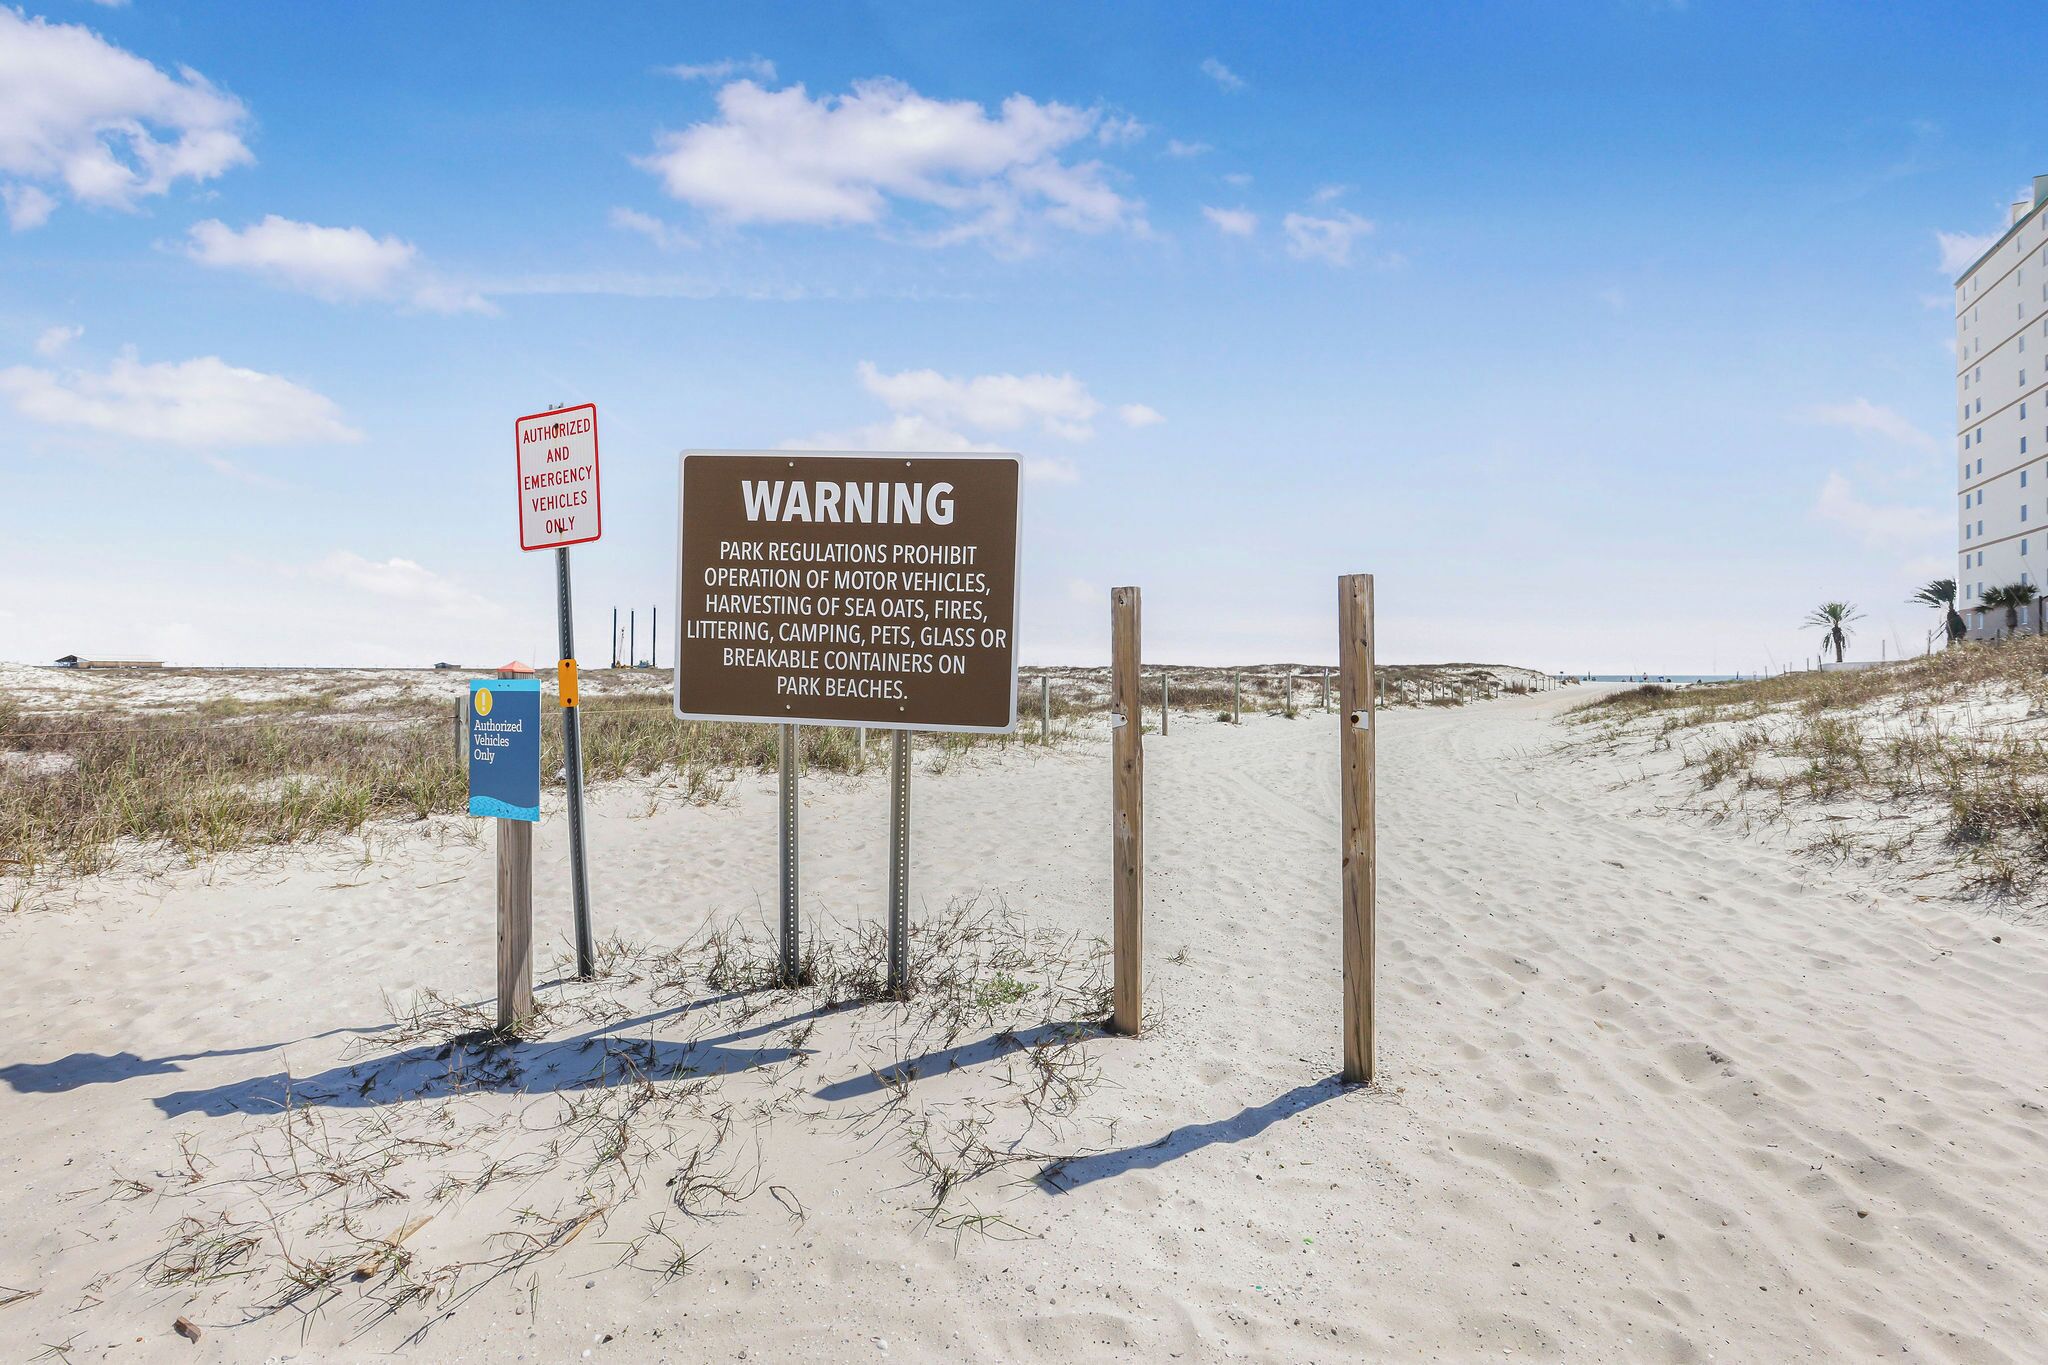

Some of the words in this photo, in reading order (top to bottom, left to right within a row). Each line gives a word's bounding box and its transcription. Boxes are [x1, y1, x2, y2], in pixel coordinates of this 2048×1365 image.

[523, 418, 591, 444] AUTHORIZED
[547, 446, 570, 464] AND
[524, 465, 593, 491] EMERGENCY
[532, 490, 588, 512] VEHICLES
[742, 480, 954, 525] WARNING
[545, 516, 575, 534] ONLY
[721, 542, 763, 560] PARK
[769, 542, 887, 563] REGULATIONS
[893, 545, 977, 564] PROHIBIT
[705, 568, 800, 588] OPERATION
[807, 570, 829, 588] OF
[835, 571, 897, 590] MOTOR
[902, 572, 990, 595] VEHICLES,
[706, 594, 811, 615] HARVESTING
[818, 597, 840, 615] OF
[845, 598, 876, 616] SEA
[881, 599, 928, 621] OATS,
[935, 600, 987, 623] FIRES,
[688, 620, 773, 643] LITTERING,
[779, 623, 865, 646] CAMPING,
[871, 626, 915, 648] PETS,
[921, 627, 975, 647] GLASS
[981, 629, 1006, 648] OR
[724, 648, 818, 668] BREAKABLE
[825, 651, 933, 673] CONTAINERS
[939, 655, 965, 674] ON
[778, 676, 820, 695] PARK
[826, 678, 907, 699] BEACHES.
[474, 719, 522, 732] Authorized
[474, 733, 509, 747] Vehicles
[474, 748, 495, 764] Only
